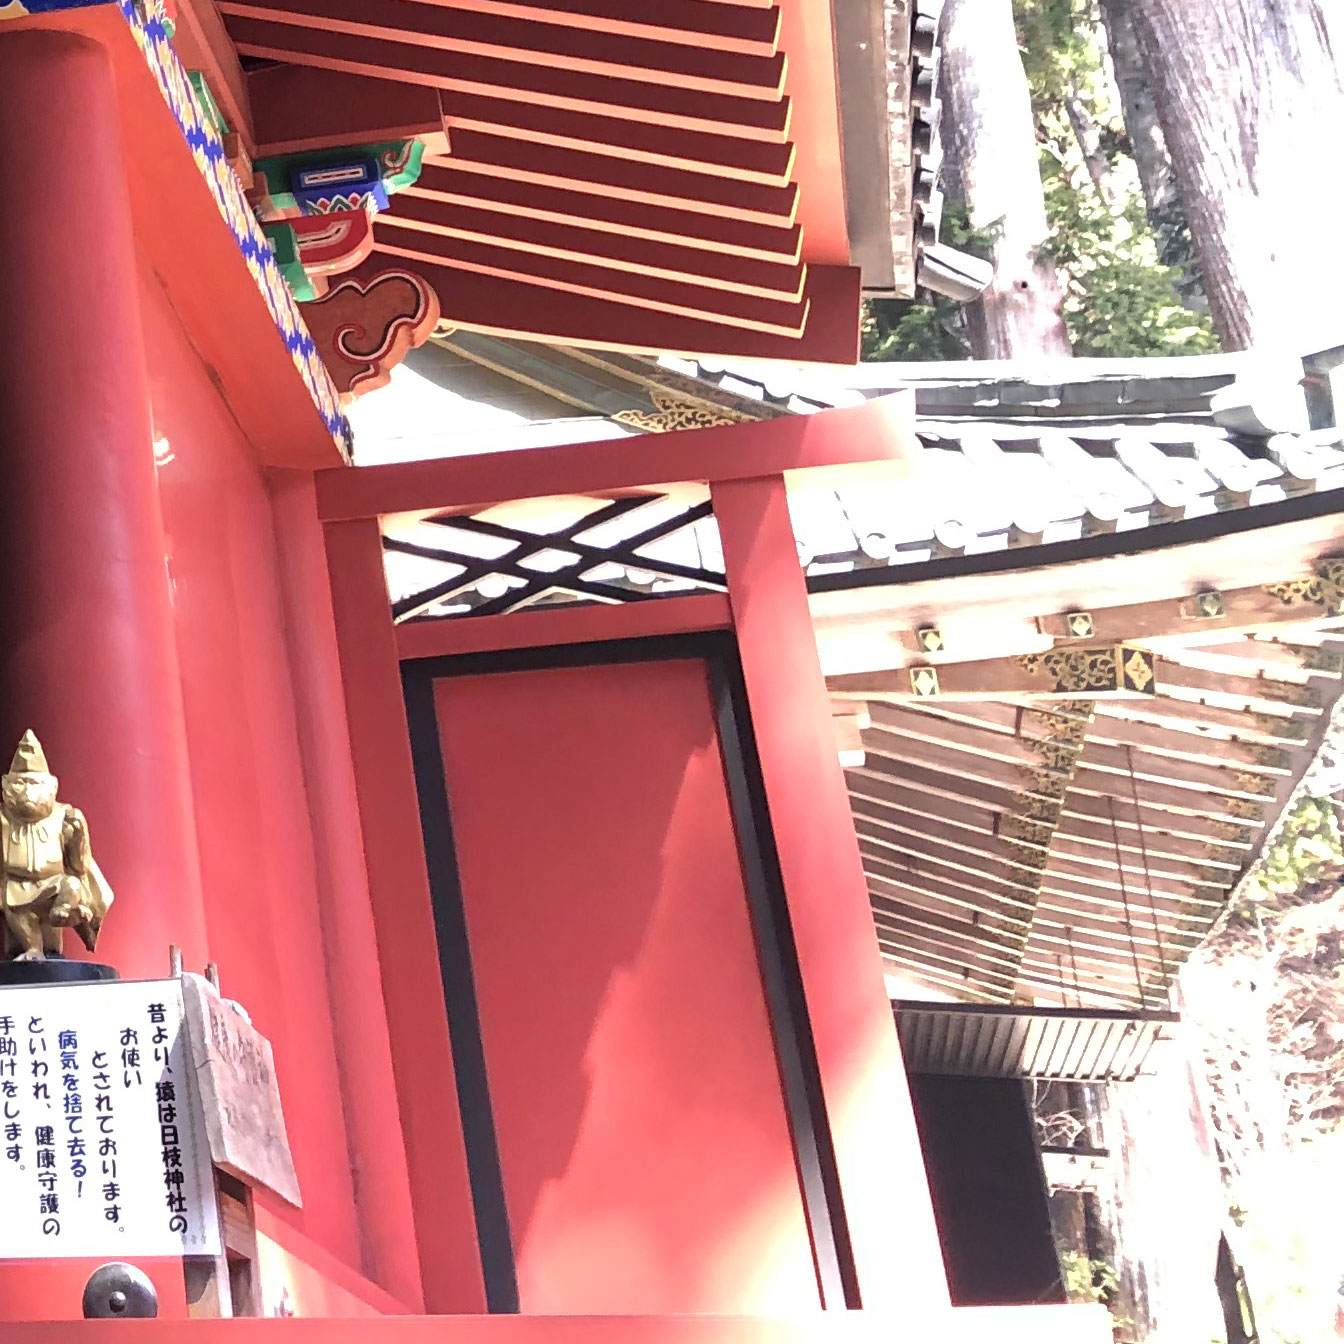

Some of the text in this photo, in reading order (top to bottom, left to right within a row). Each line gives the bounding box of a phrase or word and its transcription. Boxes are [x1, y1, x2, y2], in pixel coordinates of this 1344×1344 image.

[58, 1029, 87, 1198] 病気を捨て去る！
[92, 1050, 124, 1233] とされております。
[120, 1027, 142, 1089] お使い
[147, 1003, 188, 1234] 昔より、猿は日枝神社の
